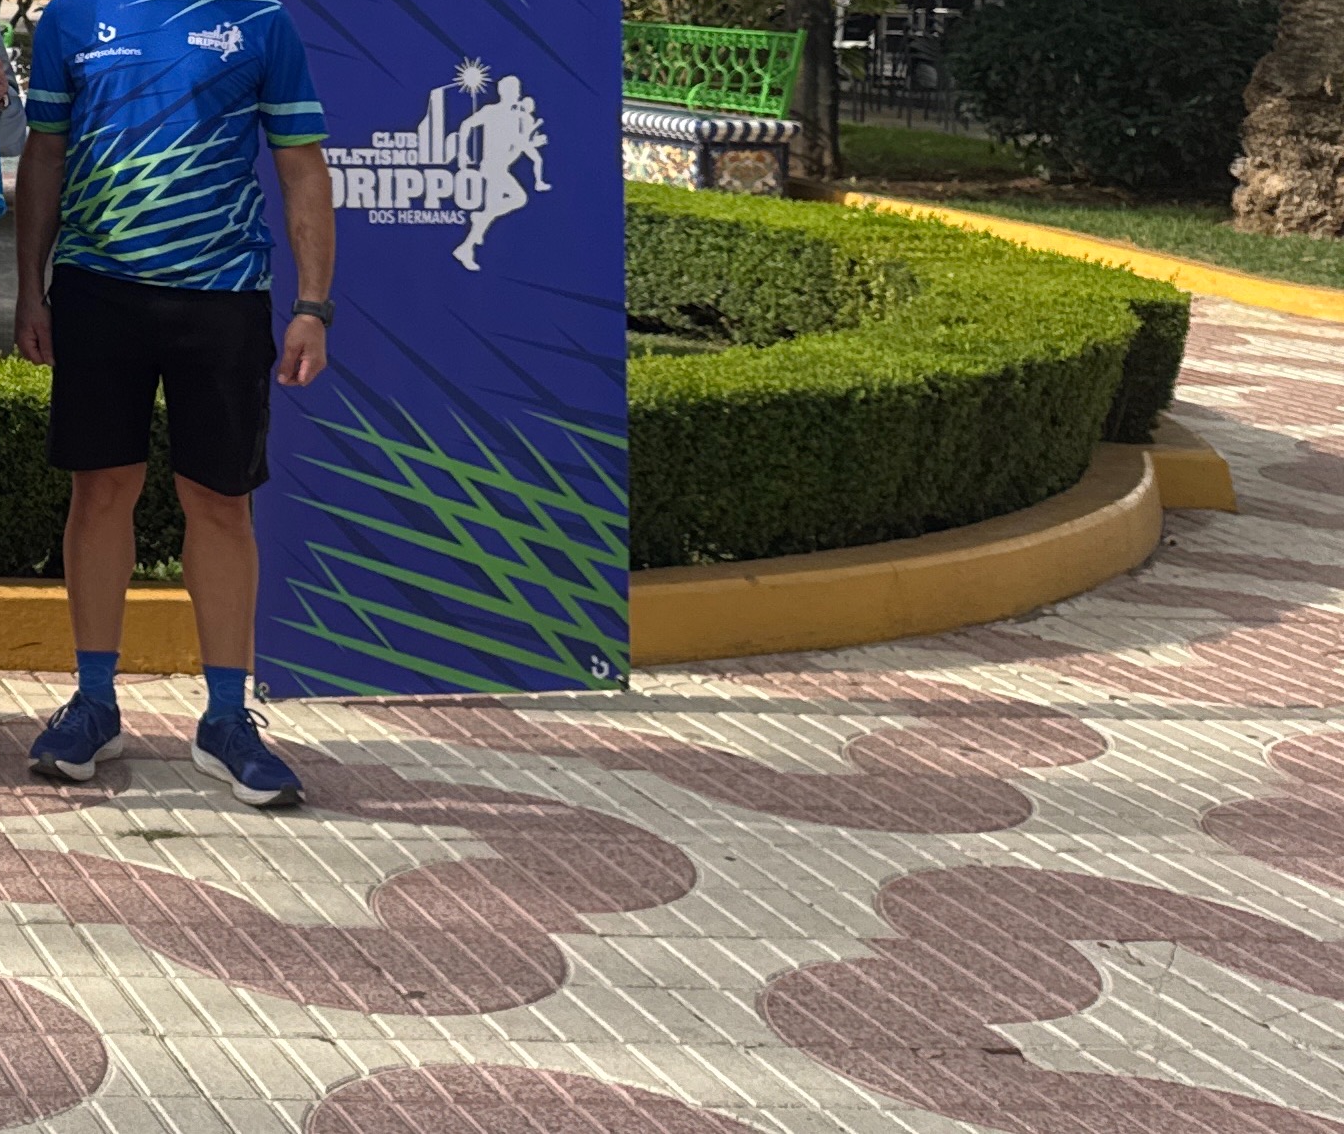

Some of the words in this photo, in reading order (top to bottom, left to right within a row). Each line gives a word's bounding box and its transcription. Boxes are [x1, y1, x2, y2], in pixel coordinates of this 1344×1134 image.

[372, 131, 418, 148] CLUB
[368, 210, 395, 224] DOS
[397, 210, 467, 225] HERMANAS
